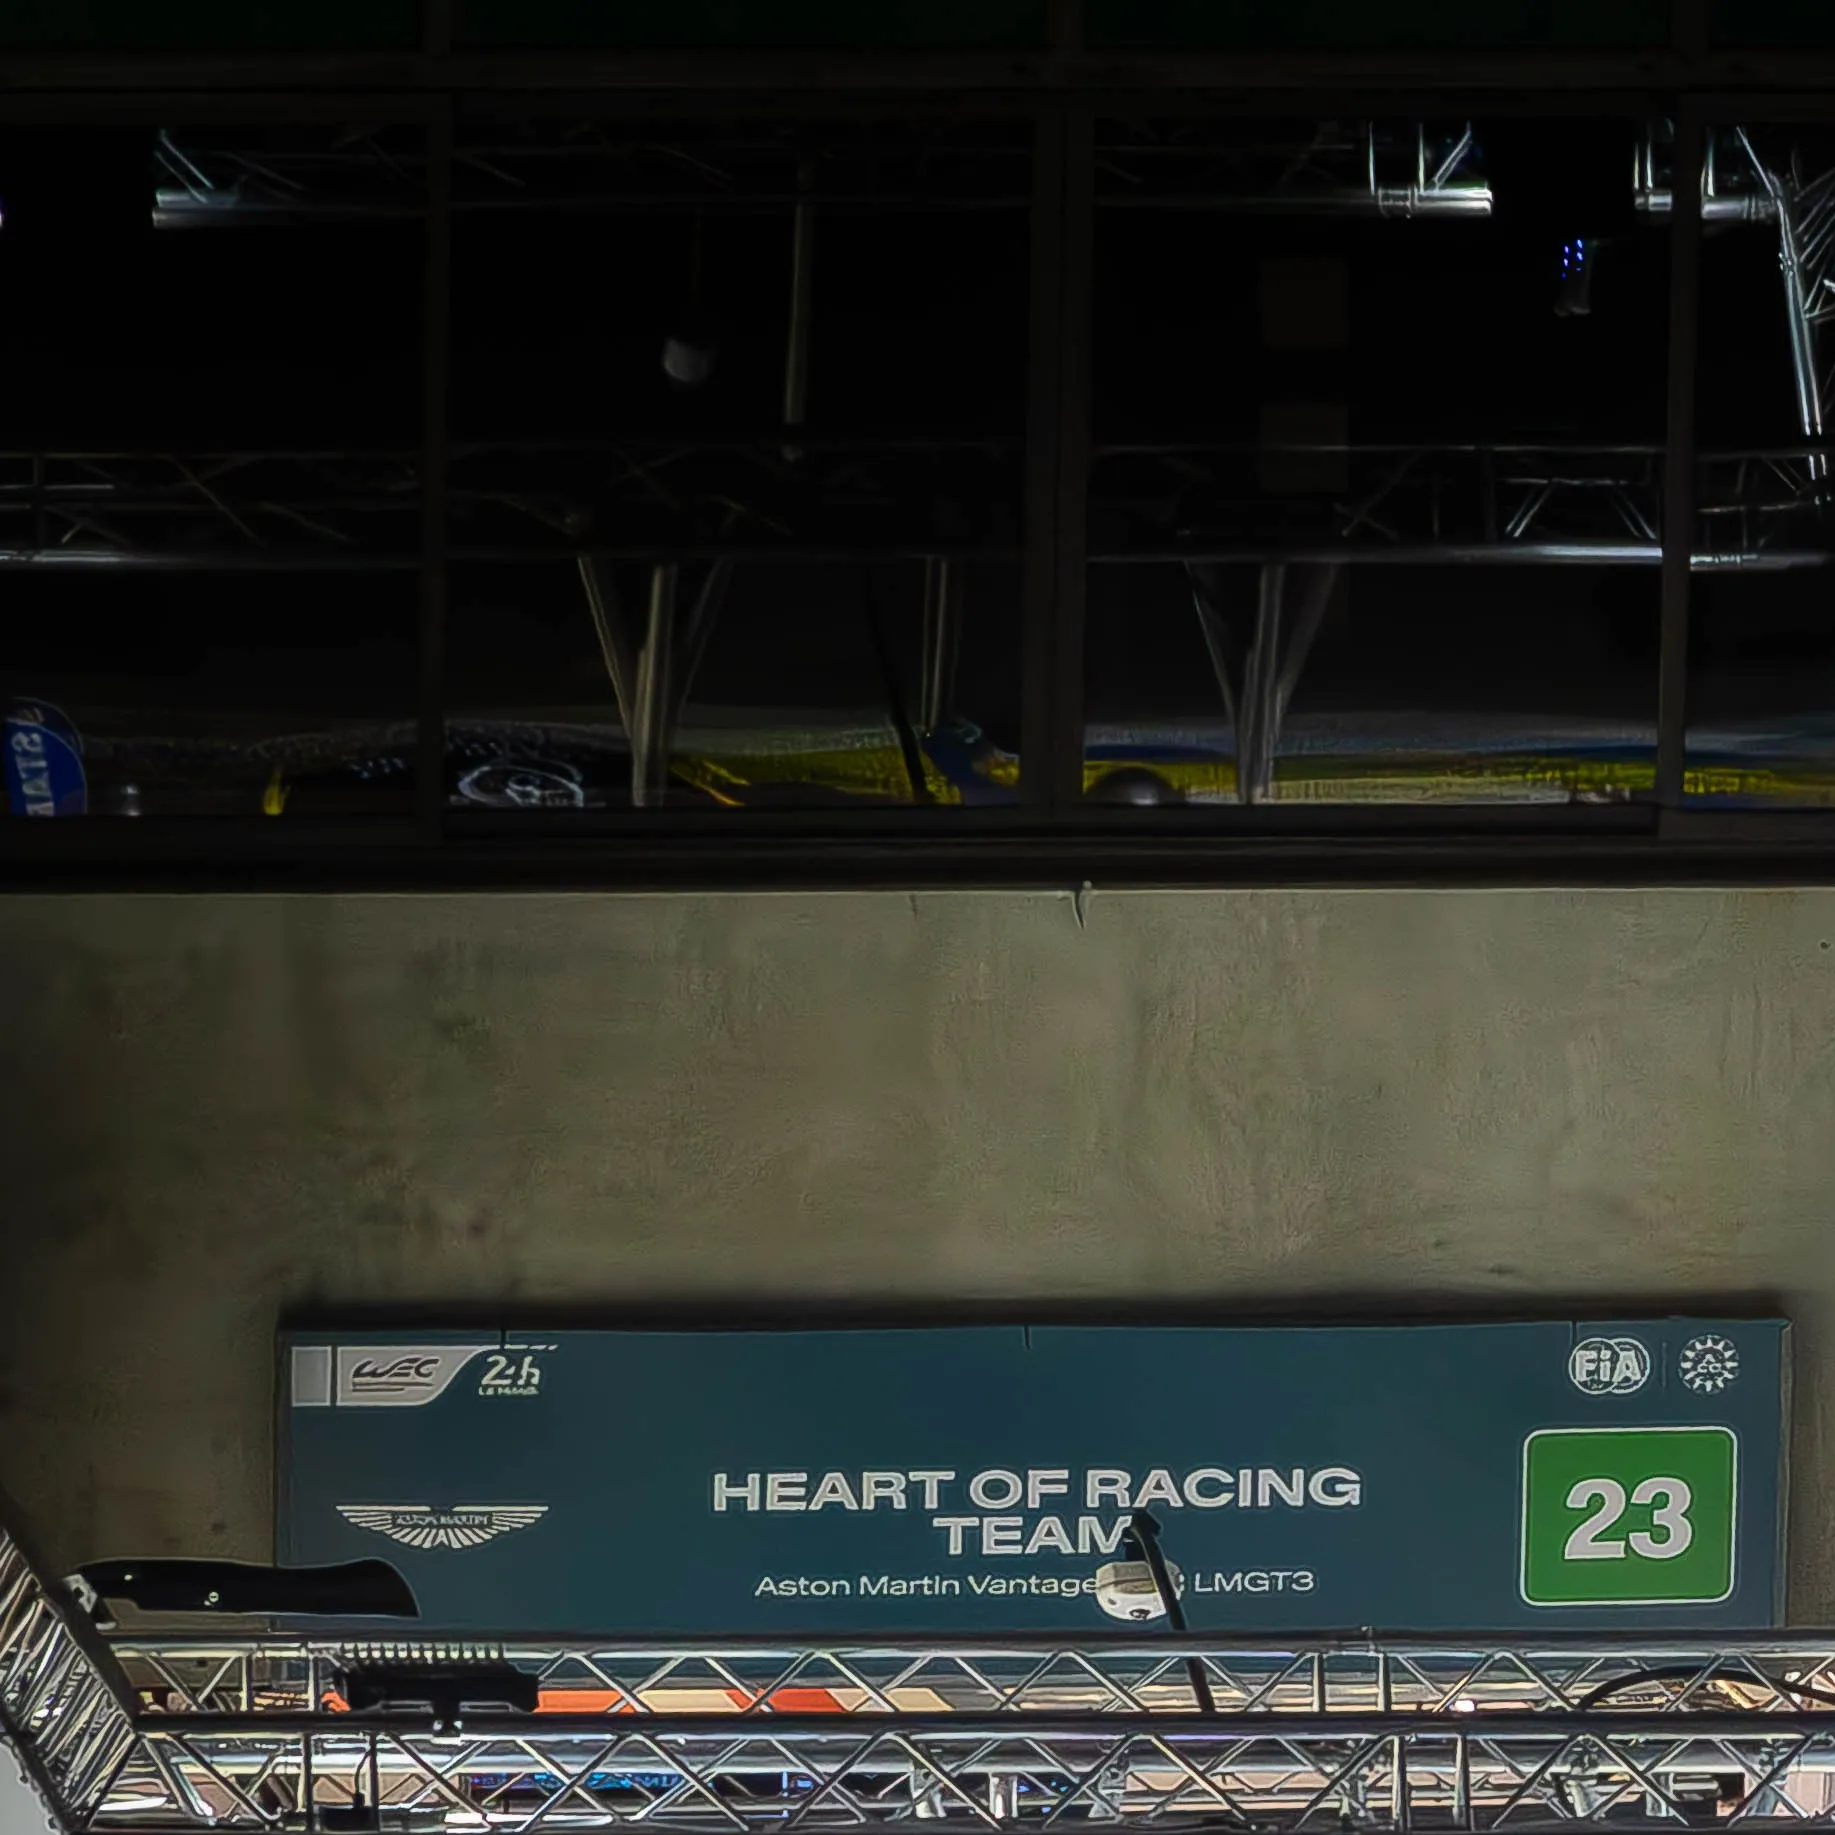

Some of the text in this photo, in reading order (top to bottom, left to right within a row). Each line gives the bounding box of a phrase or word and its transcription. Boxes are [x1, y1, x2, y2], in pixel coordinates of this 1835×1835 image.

[713, 1467, 1361, 1511] HEART OF RACING
[932, 1515, 1132, 1556] TEAM
[1564, 1476, 1693, 1560] 23
[755, 1570, 1315, 1600] Aston Martin Vantage LMGT3
